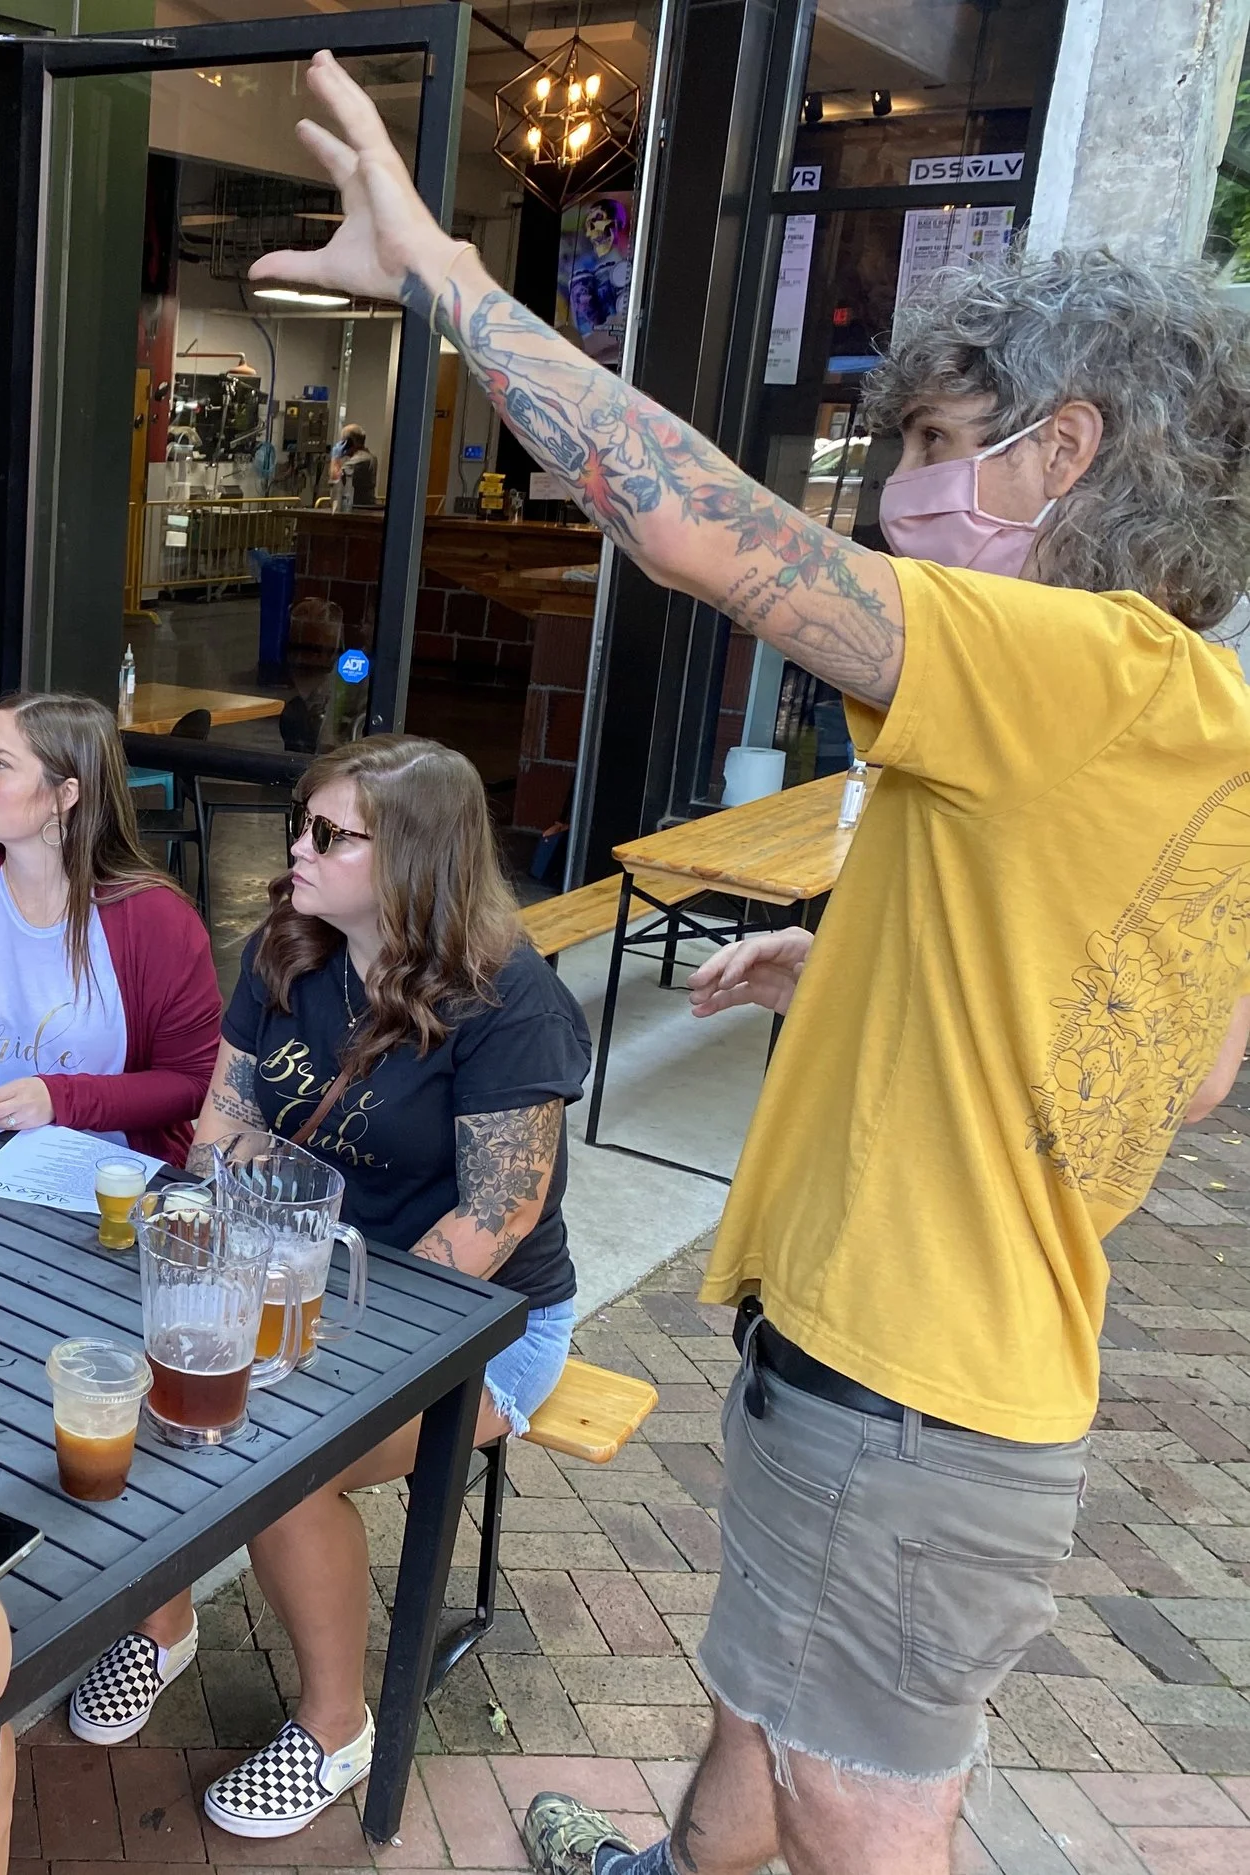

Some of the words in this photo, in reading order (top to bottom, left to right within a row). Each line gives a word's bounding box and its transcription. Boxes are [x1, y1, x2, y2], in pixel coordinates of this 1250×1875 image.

[342, 658, 366, 672] ADT
[1110, 901, 1136, 936] BREWED
[1134, 875, 1154, 900] UNTIL
[1152, 832, 1179, 872] SURREAL
